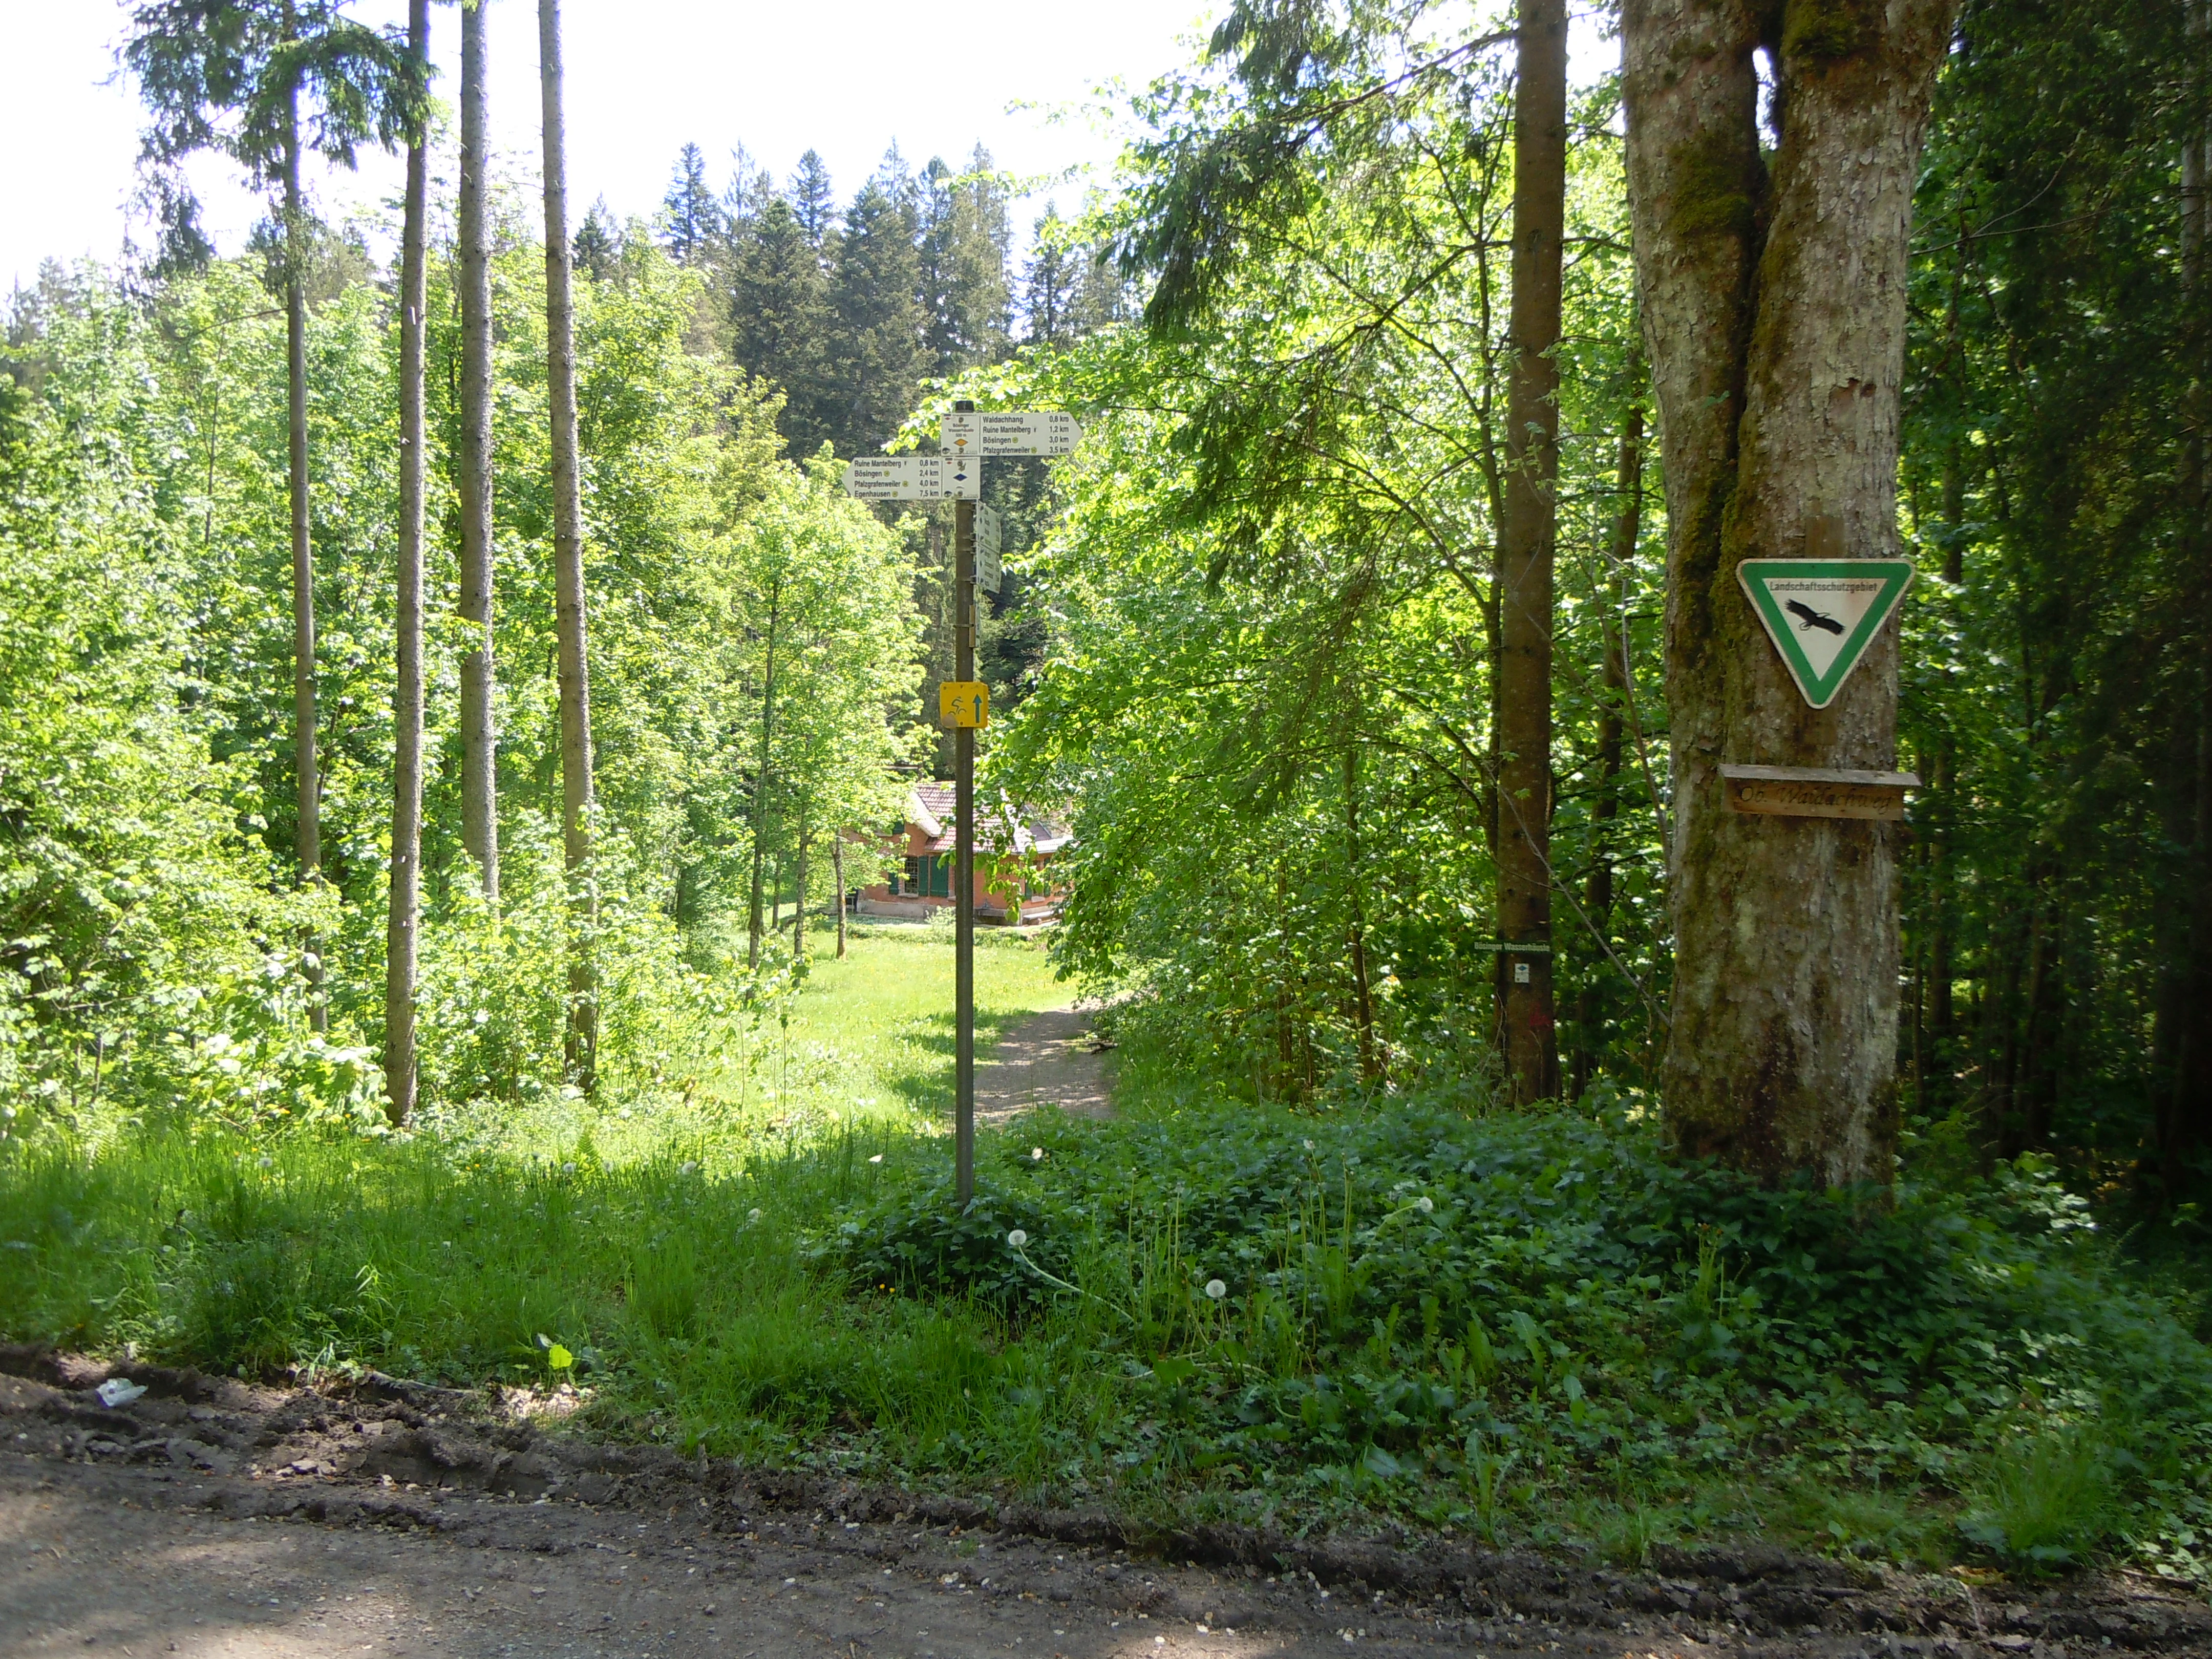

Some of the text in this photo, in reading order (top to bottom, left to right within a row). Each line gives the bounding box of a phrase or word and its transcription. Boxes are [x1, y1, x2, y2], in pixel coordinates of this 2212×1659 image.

[983, 416, 1024, 424] Waldachhang
[1049, 415, 1058, 423] 0,8
[1000, 426, 1031, 435] Mantelberg
[983, 436, 1011, 445] Bösingen
[1049, 436, 1058, 444] 3,0
[983, 446, 1030, 455] Pfalzgrafenweiler
[1049, 446, 1058, 454] 3,5
[871, 460, 901, 469] Mantelberg
[854, 470, 882, 479] Bösingen
[854, 480, 901, 489] Pfalzgrafenweiler
[854, 491, 891, 499] Egenhausen
[1770, 582, 1878, 593] Landschaftsschutzgebiet
